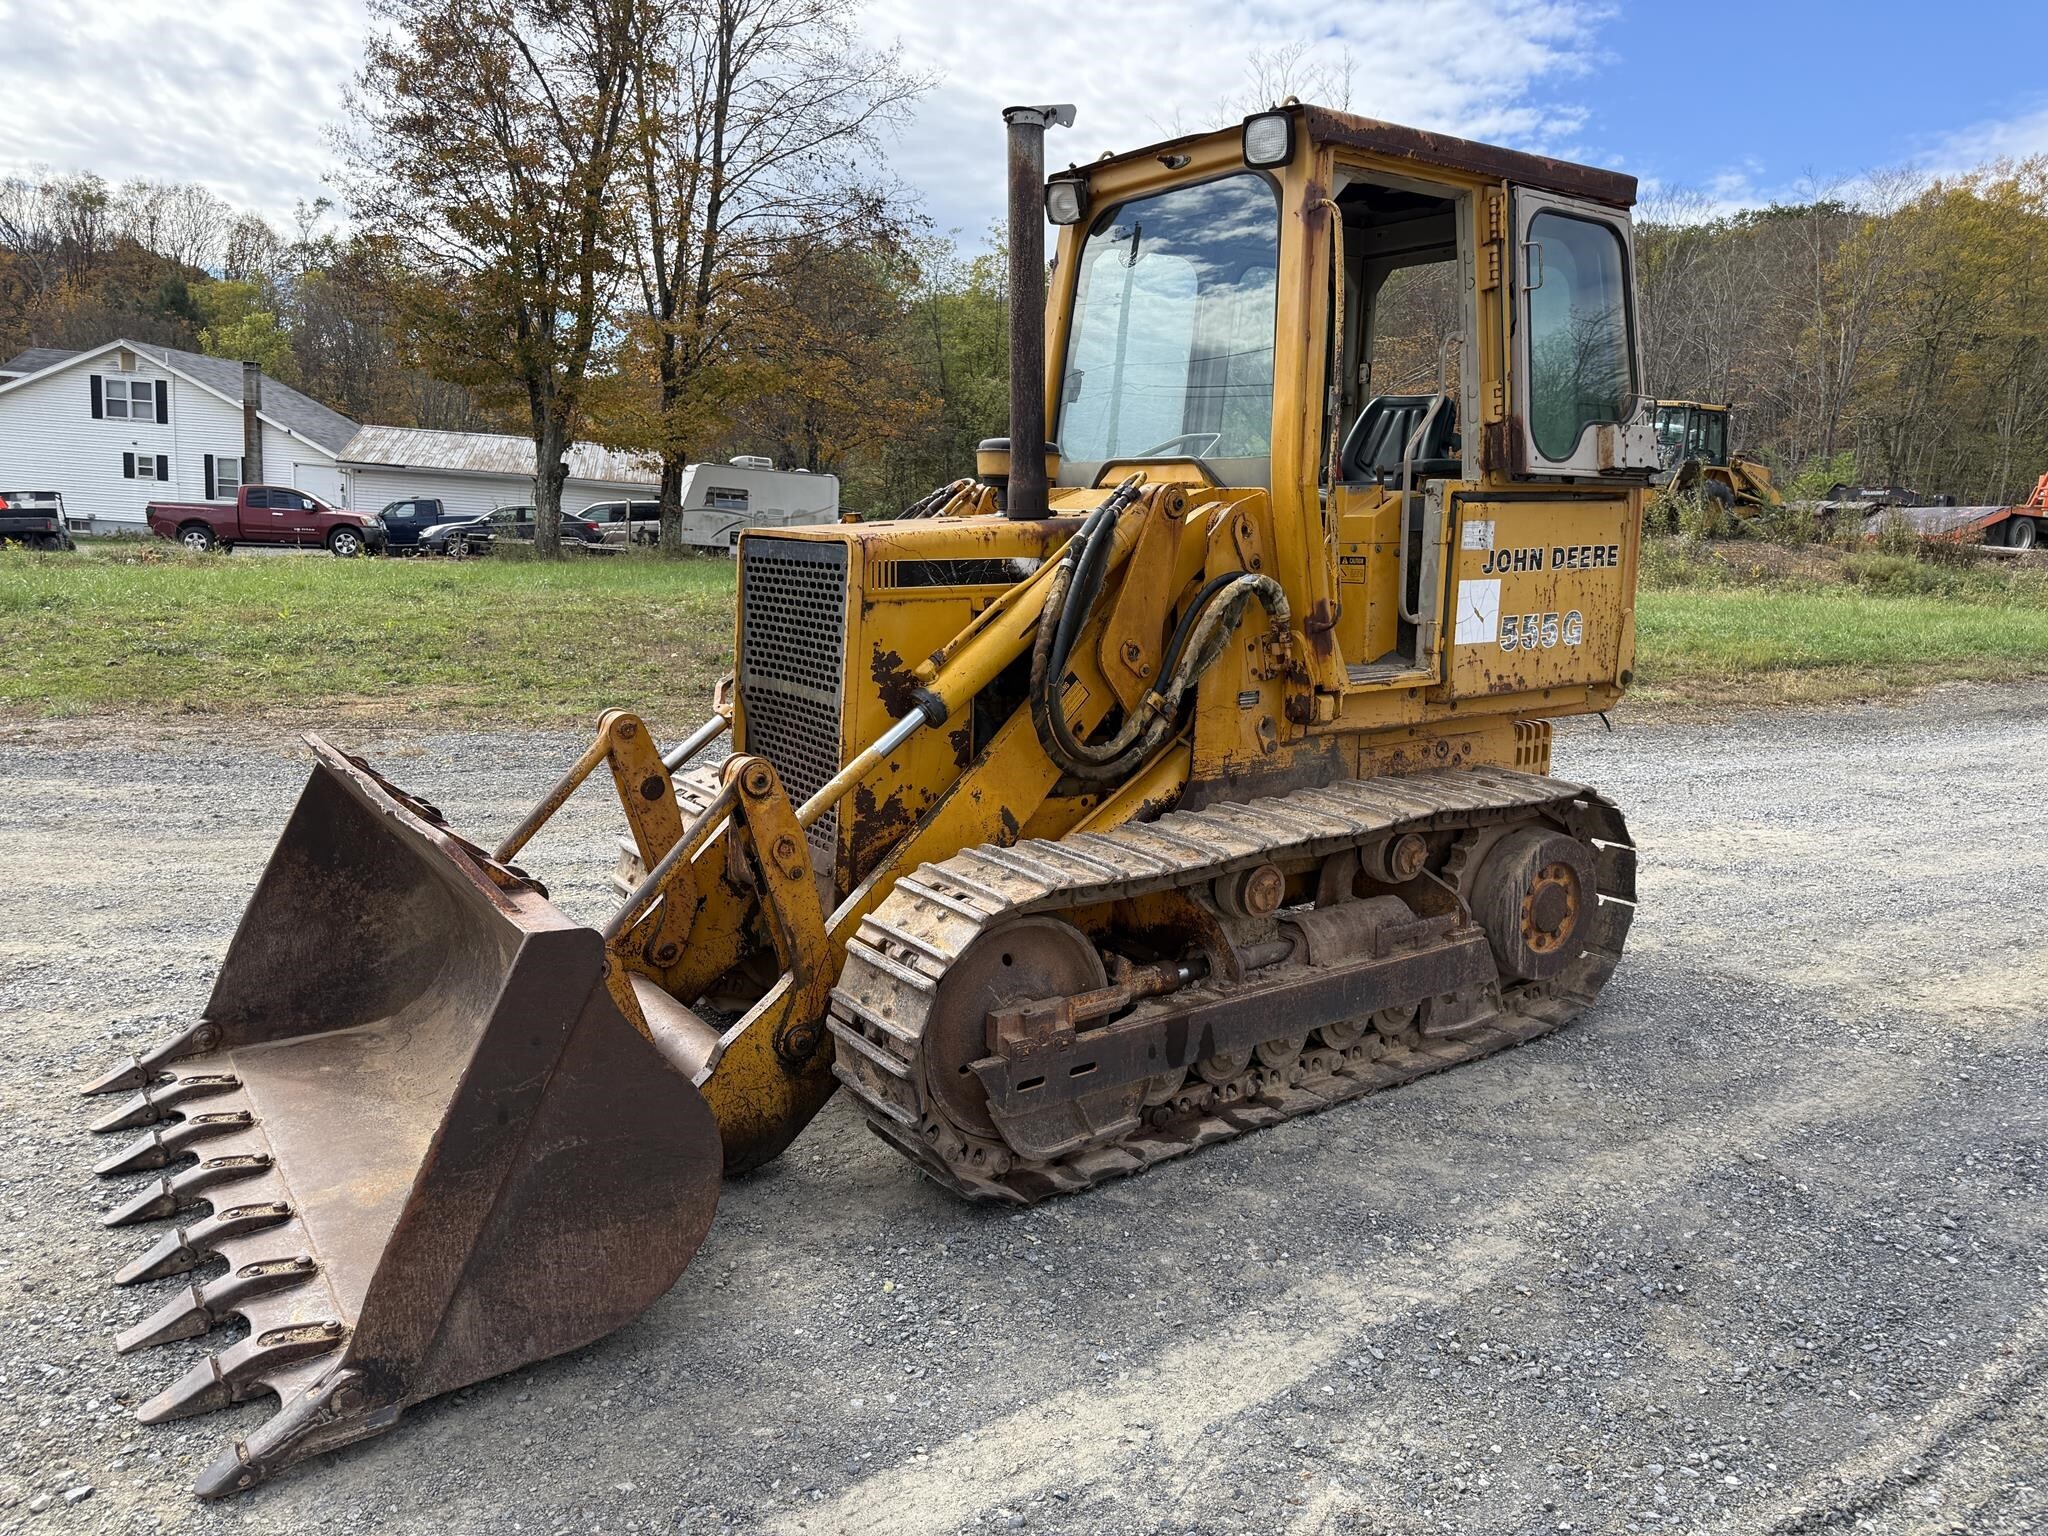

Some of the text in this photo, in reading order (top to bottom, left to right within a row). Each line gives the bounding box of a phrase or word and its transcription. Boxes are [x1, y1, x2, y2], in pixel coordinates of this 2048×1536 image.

[1482, 544, 1619, 574] JOHN DEERE
[1499, 609, 1583, 651] 555G
